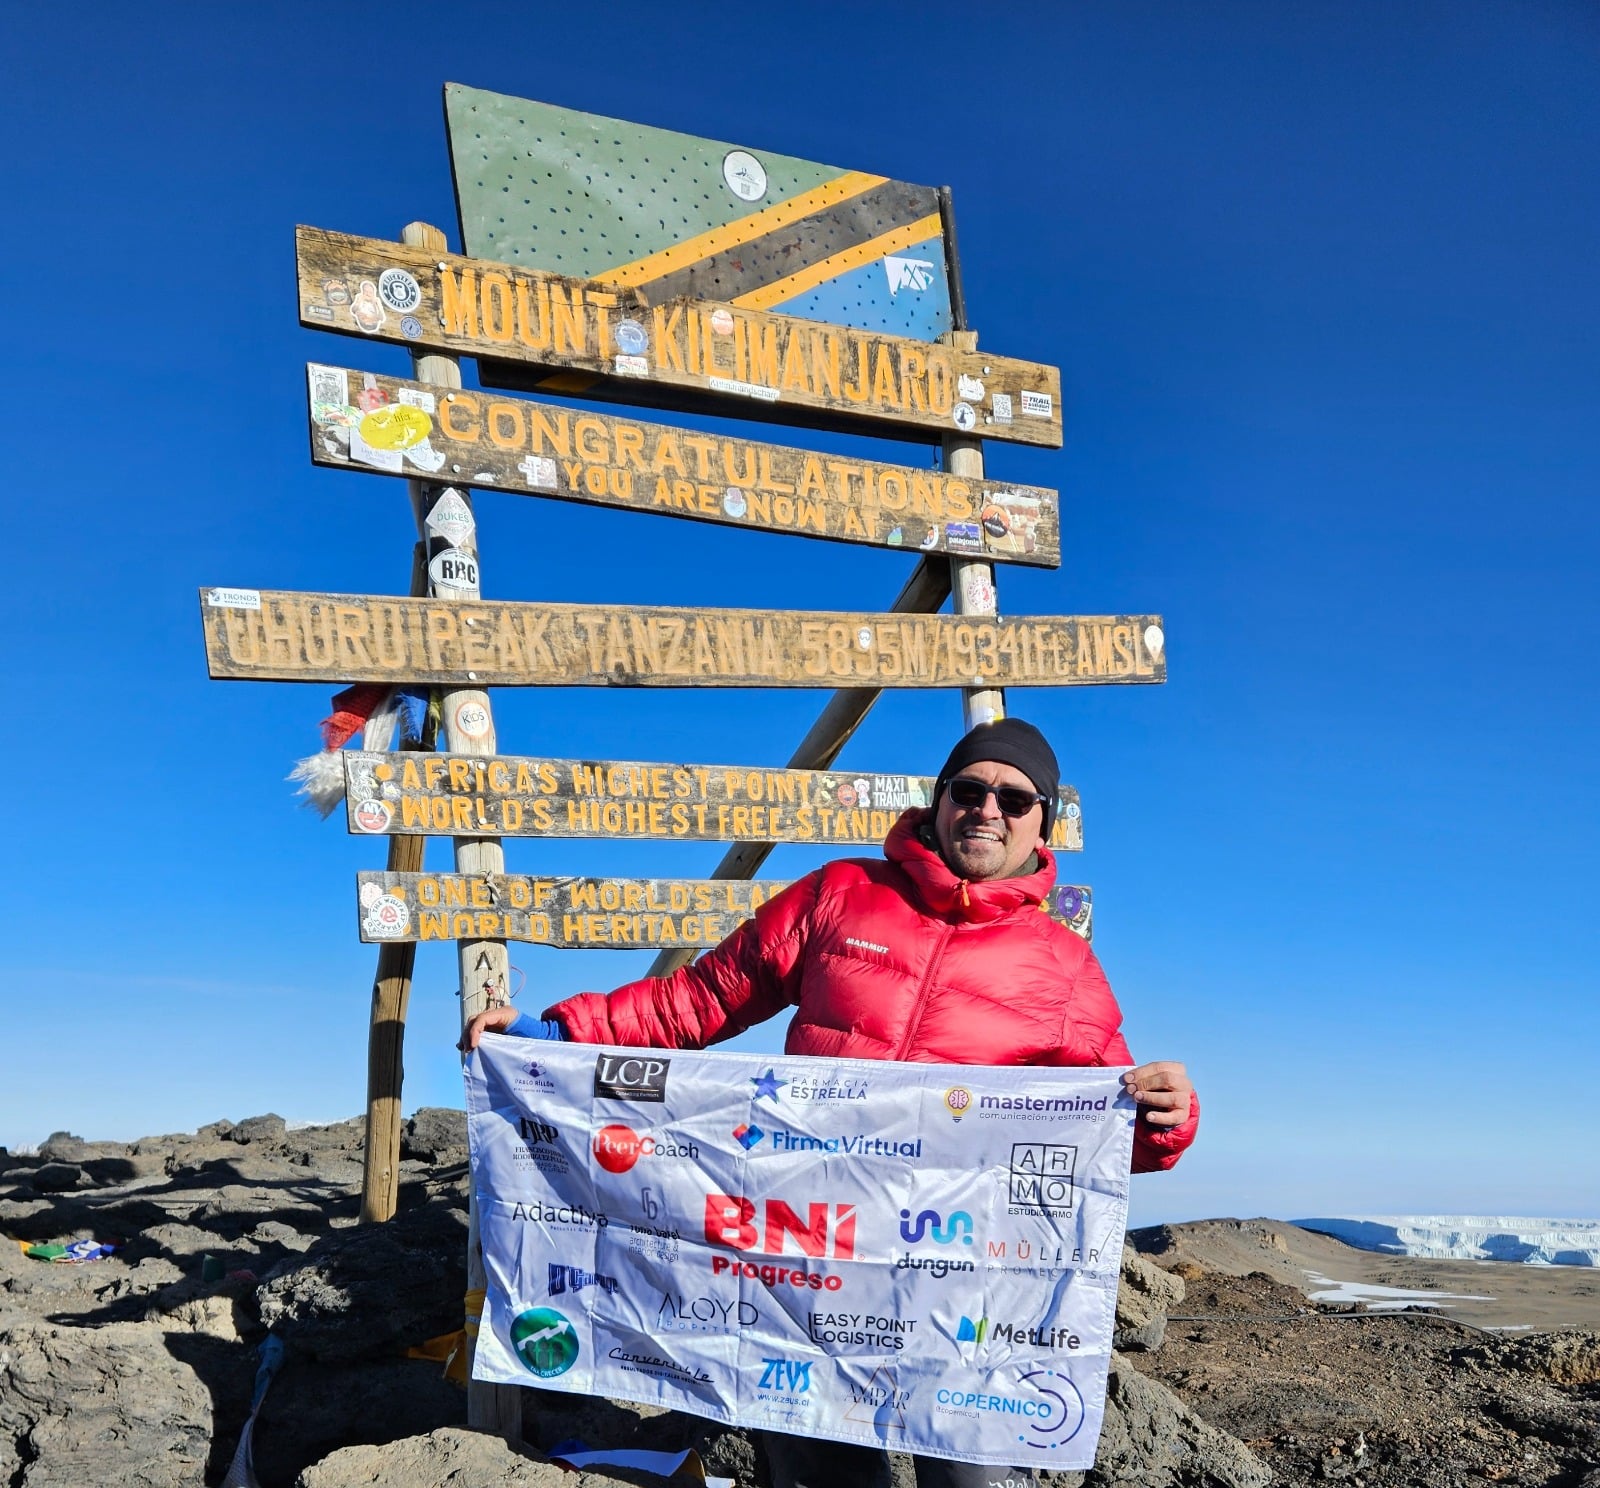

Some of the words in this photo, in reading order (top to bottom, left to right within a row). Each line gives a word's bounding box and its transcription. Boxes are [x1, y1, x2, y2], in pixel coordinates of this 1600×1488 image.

[441, 265, 617, 360] MOUNT
[652, 304, 953, 415] KILIMANJARO
[438, 393, 973, 519] CONGRATULATIONS
[564, 462, 634, 498] YOU
[653, 479, 721, 517] ARE
[744, 489, 826, 531] NOW
[844, 508, 879, 539] AT
[437, 512, 470, 523] DUKES
[948, 536, 979, 547] patagonia
[223, 593, 257, 602] TRONDS
[225, 602, 406, 668] UHURU
[1077, 624, 1155, 676] AMSL
[572, 764, 710, 798] HIGHEST
[725, 771, 812, 802] POINT
[875, 777, 905, 792] MAXI
[401, 796, 555, 831] WORLD'S
[567, 799, 708, 834] HIGHEST
[417, 878, 490, 908] ONE
[510, 881, 555, 909] OF
[418, 911, 549, 940] WORLD
[563, 913, 722, 943] HERITAGE
[845, 937, 889, 954] MAMMUT
[600, 1057, 664, 1086] LCP
[791, 1076, 868, 1088] FARMACIA
[791, 1086, 867, 1100] ESTRELLA
[980, 1096, 1108, 1112] mastermind
[1049, 1114, 1055, 1122] y
[592, 1132, 699, 1159] PeerCoach
[773, 1130, 922, 1158] FirmaVirtual
[512, 1201, 609, 1228] Adactiva
[705, 1194, 857, 1260] BNI
[988, 1239, 1100, 1264] MÜLLER
[711, 1255, 843, 1291] Progreso
[896, 1252, 974, 1279] dungun
[987, 1265, 1097, 1280] PROYECTOS
[657, 1293, 759, 1326] ALOYD
[813, 1312, 861, 1329] EASY
[865, 1315, 917, 1333] POINT
[813, 1328, 904, 1350] LOGISTICS
[992, 1322, 1081, 1350] MetLife
[757, 1357, 815, 1393] ZEUS
[937, 1388, 1052, 1418] COPERNICO
